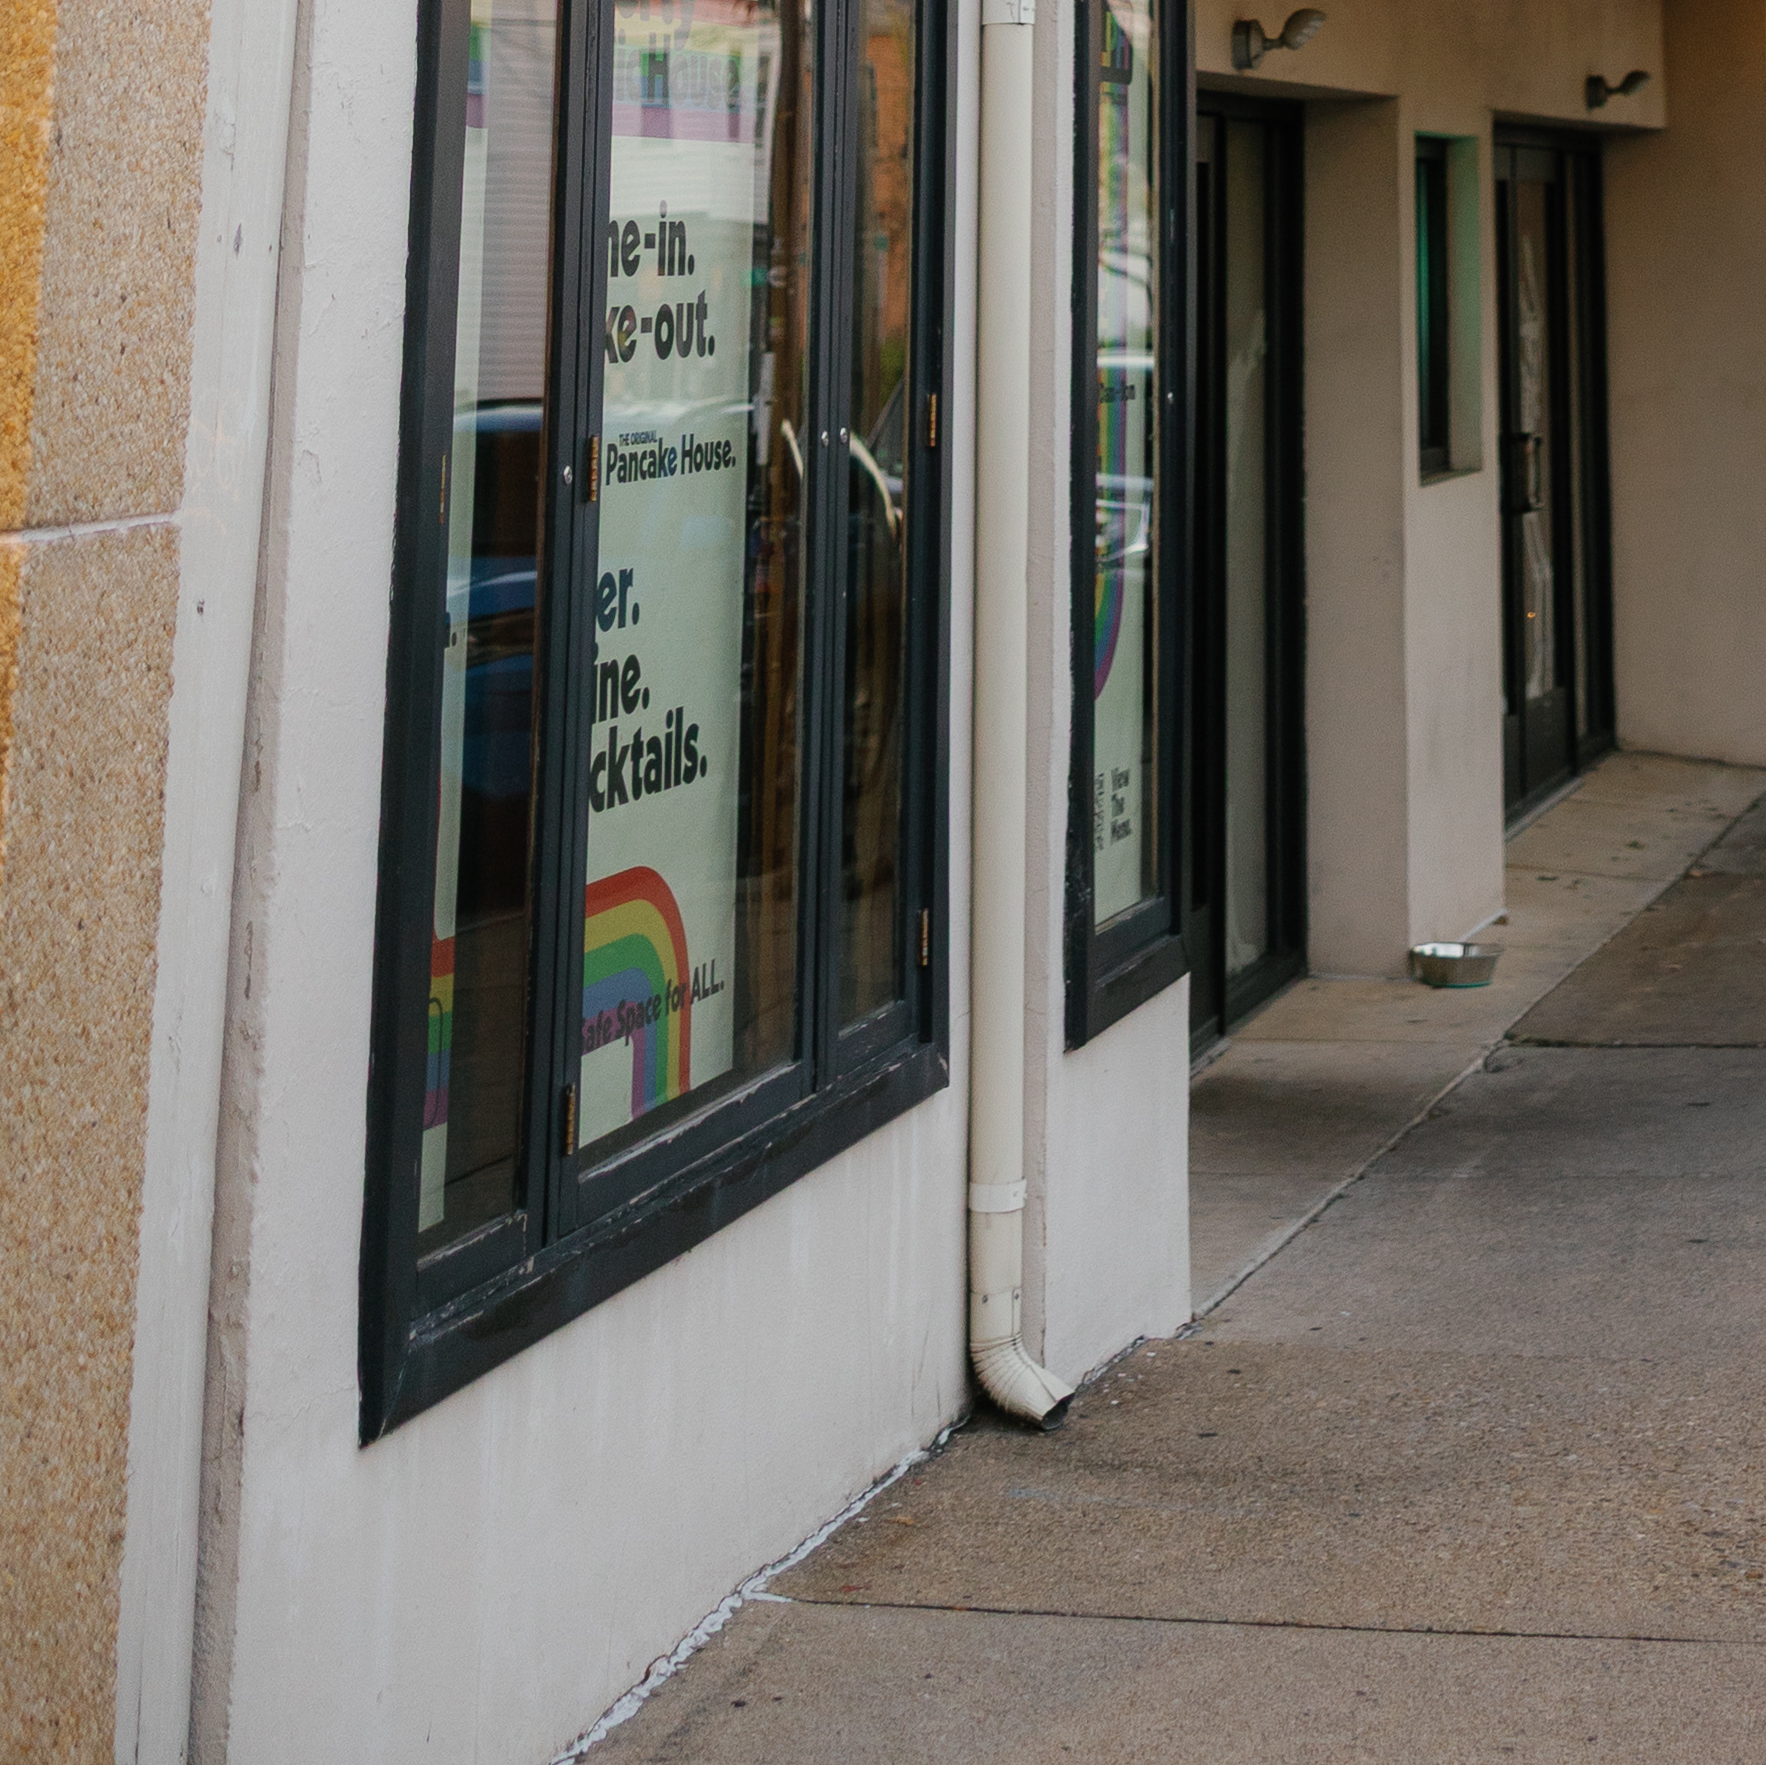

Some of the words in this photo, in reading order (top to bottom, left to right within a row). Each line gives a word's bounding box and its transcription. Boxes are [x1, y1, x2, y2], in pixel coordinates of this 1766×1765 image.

[605, 437, 678, 486] Pancake
[680, 433, 736, 476] House.
[618, 432, 630, 447] THE
[630, 429, 657, 446] ORIGINAL
[615, 994, 662, 1047] Space
[665, 978, 687, 1017] for
[690, 958, 725, 1006] ALL.
